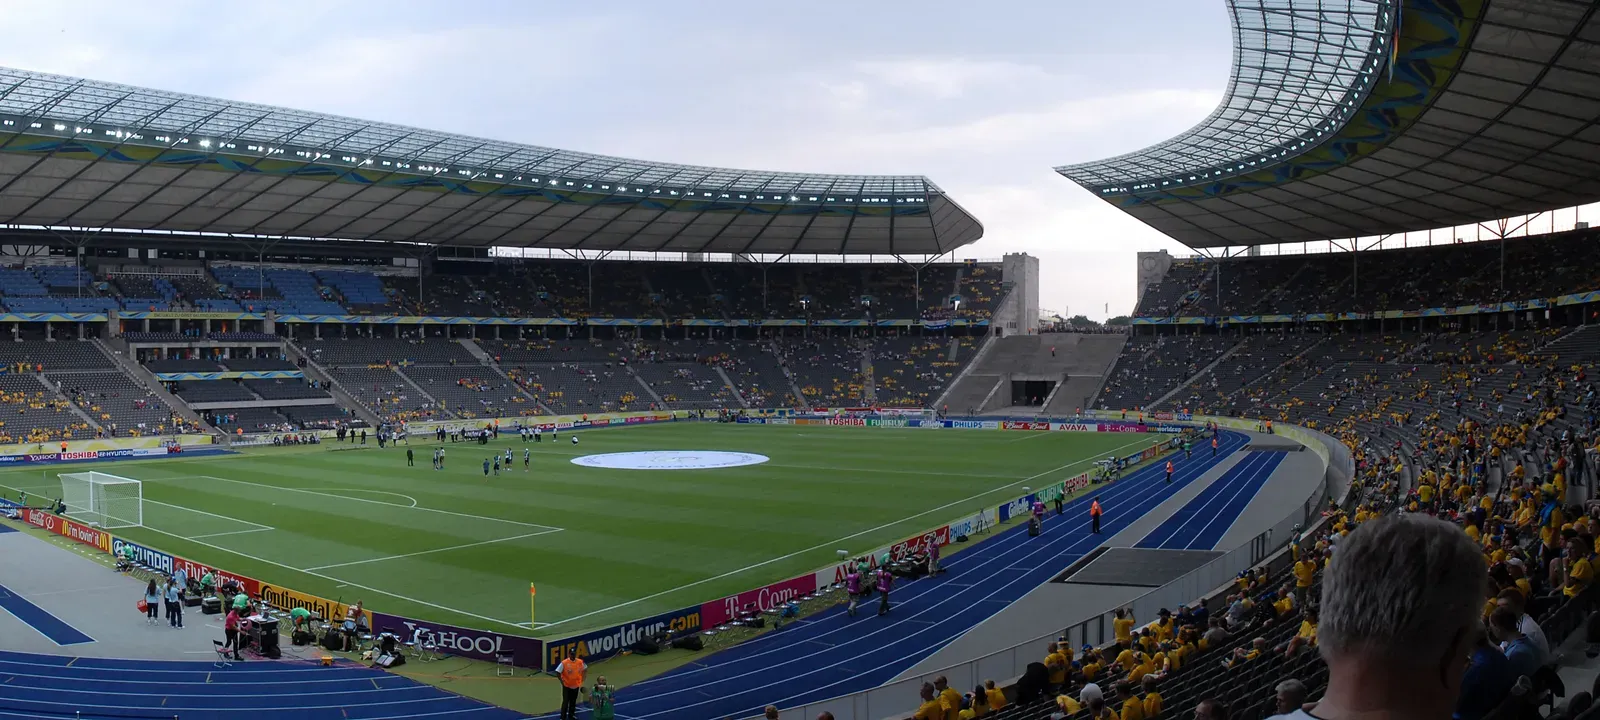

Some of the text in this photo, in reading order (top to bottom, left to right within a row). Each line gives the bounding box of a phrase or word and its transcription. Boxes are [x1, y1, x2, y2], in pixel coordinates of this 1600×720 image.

[871, 419, 905, 427] FUJIFILM
[29, 454, 57, 462] YAHOO!
[62, 451, 97, 459] TOSHIBA
[1008, 498, 1029, 518] Gillette
[950, 521, 971, 539] PHILIPS
[127, 544, 173, 575] YUNDAI
[261, 585, 330, 620] Continental
